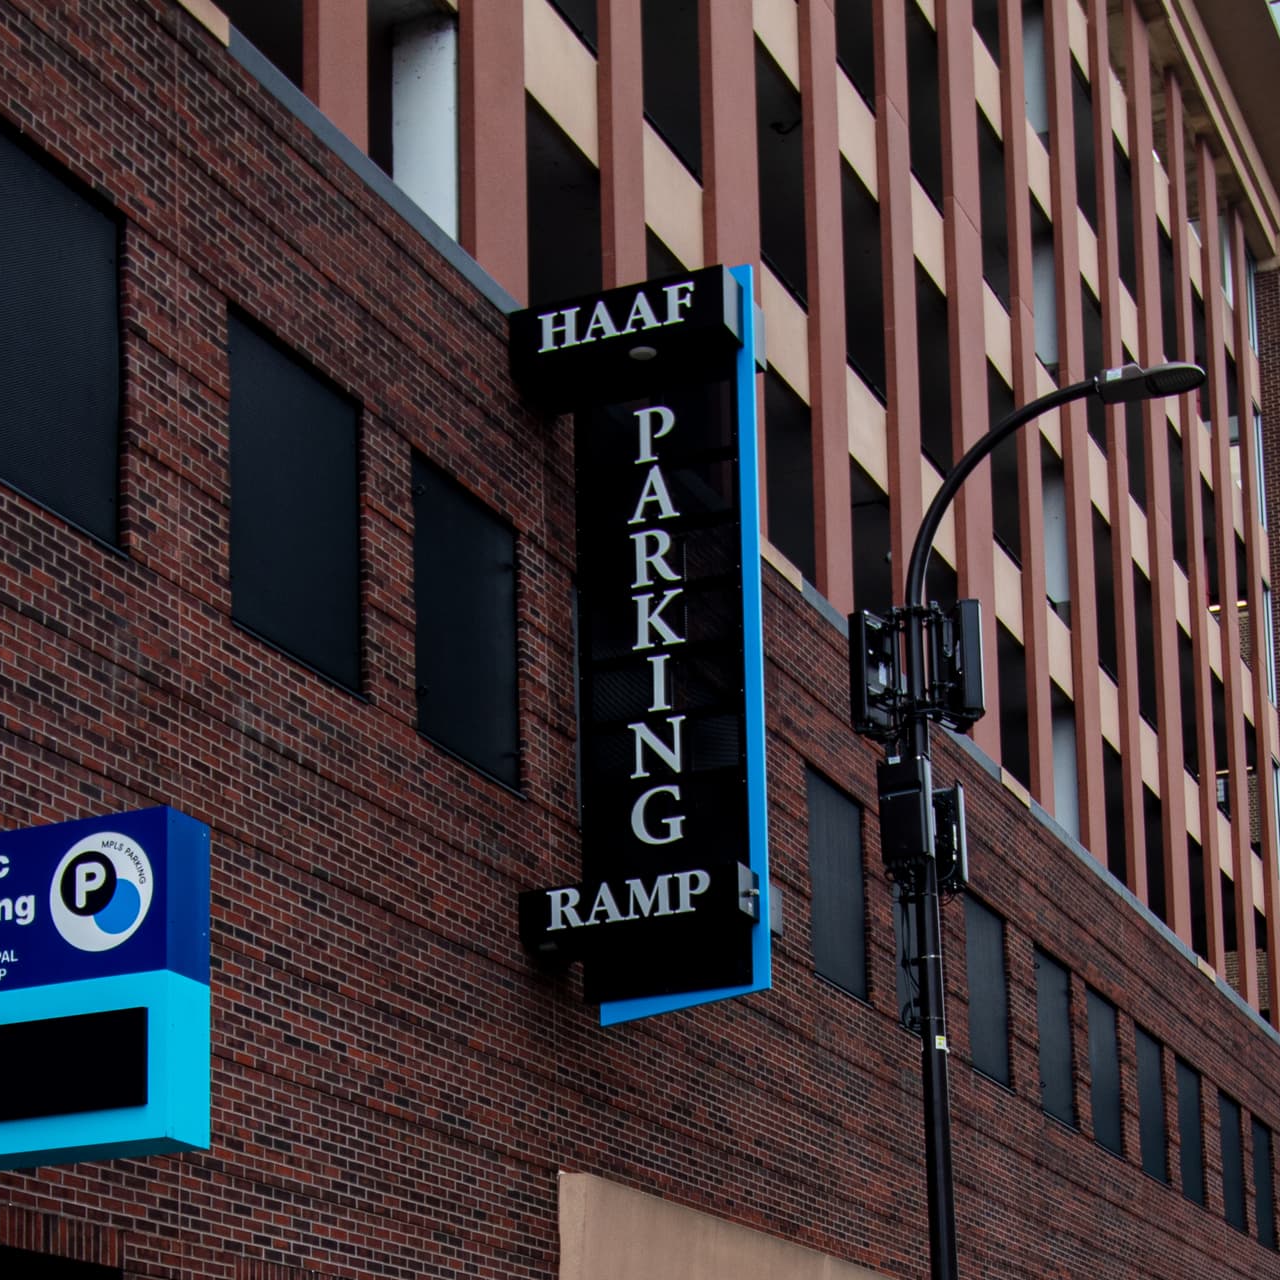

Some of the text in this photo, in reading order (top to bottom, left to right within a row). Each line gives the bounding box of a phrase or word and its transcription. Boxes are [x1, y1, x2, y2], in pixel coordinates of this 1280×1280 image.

[537, 281, 695, 353] HAAF
[627, 406, 686, 845] PARKING
[75, 861, 106, 909] P
[101, 840, 147, 885] MPLS PARKING
[546, 869, 711, 931] RAMP
